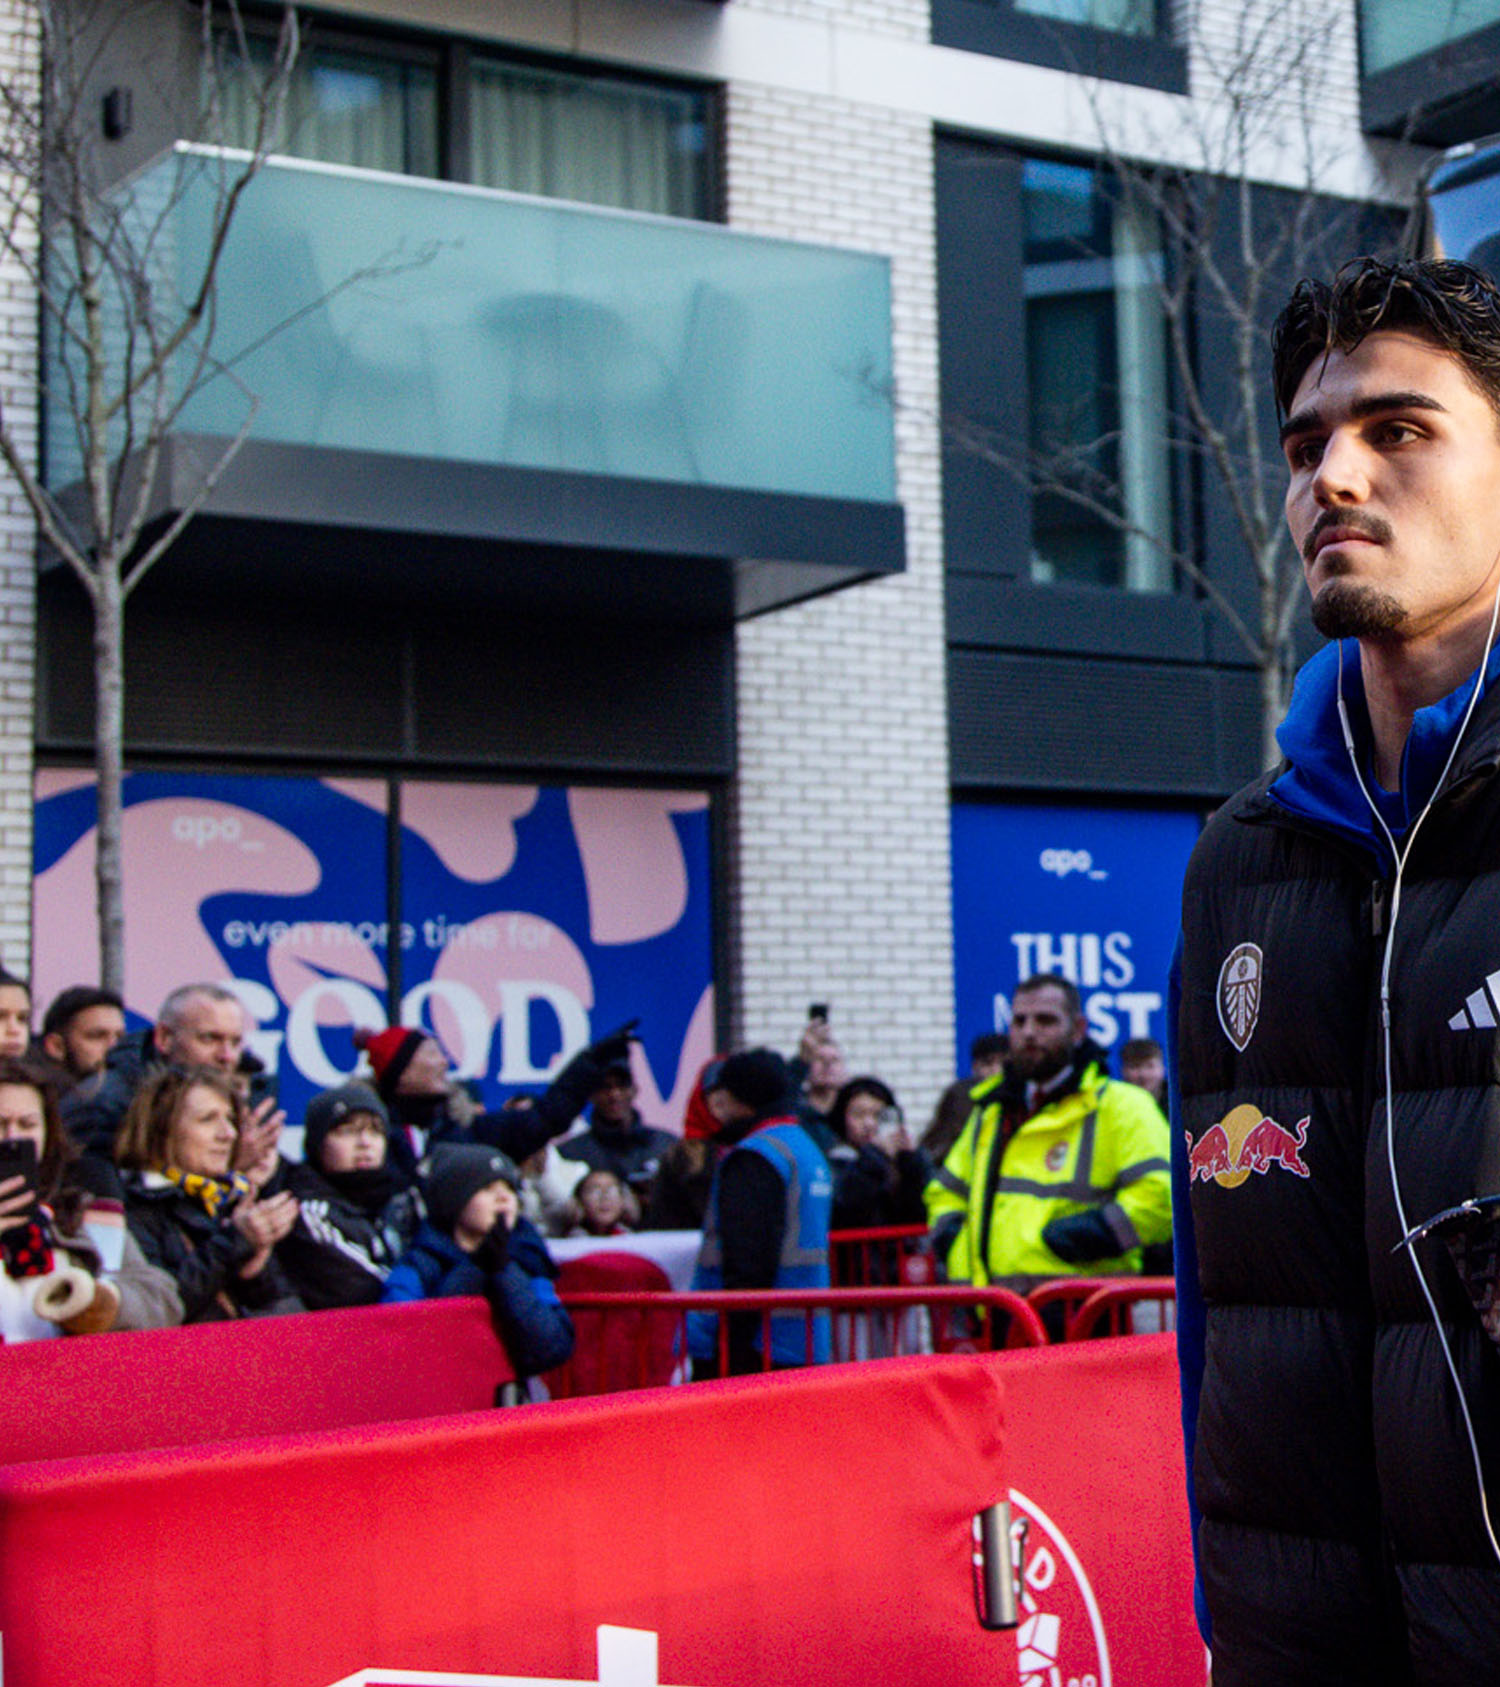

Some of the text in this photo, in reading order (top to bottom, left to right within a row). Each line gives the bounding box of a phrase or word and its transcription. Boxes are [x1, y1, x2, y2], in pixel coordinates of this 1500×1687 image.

[223, 914, 556, 951] even more time for
[1010, 931, 1135, 988] THIS
